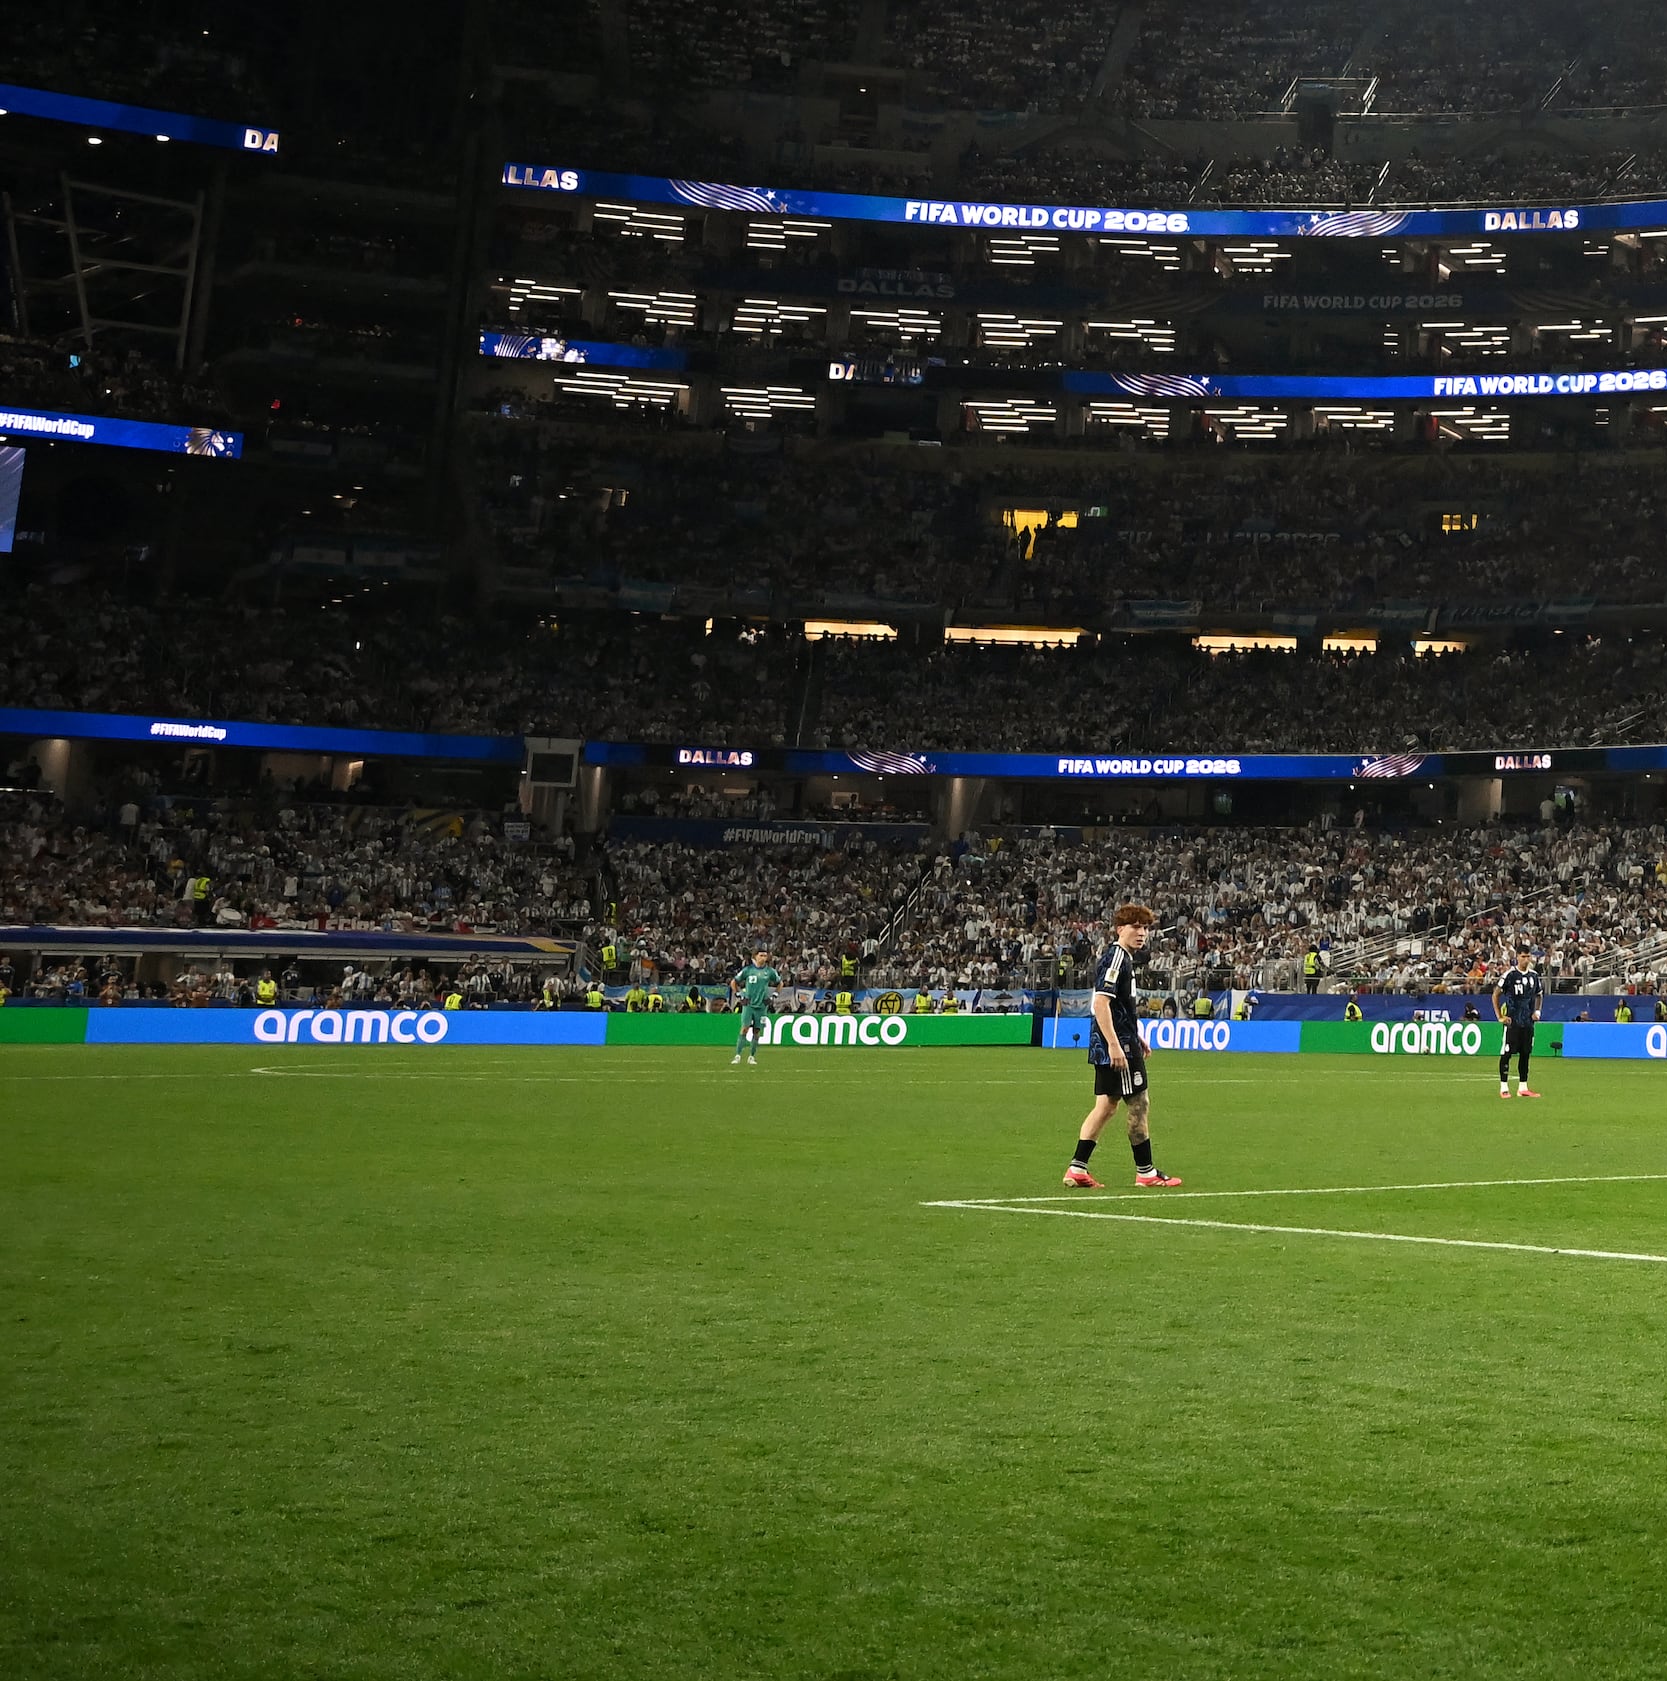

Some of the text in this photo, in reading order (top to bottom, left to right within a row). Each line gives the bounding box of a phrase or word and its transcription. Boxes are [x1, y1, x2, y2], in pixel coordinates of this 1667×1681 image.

[905, 201, 1187, 232] FIFA WORLD CUP 2026
[1484, 209, 1579, 231] DALLAS
[1263, 295, 1463, 310] FIFA WORLD CUP 2026
[1433, 371, 1667, 396] FIFA WORLD CUP 2026
[678, 749, 753, 766] DALLAS
[1058, 758, 1241, 774] FIFA WORLD CUP 2026
[1495, 754, 1552, 770] DALLAS
[1513, 982, 1525, 995] 14
[254, 1010, 448, 1043] aramco
[1371, 1022, 1481, 1055] aramco
